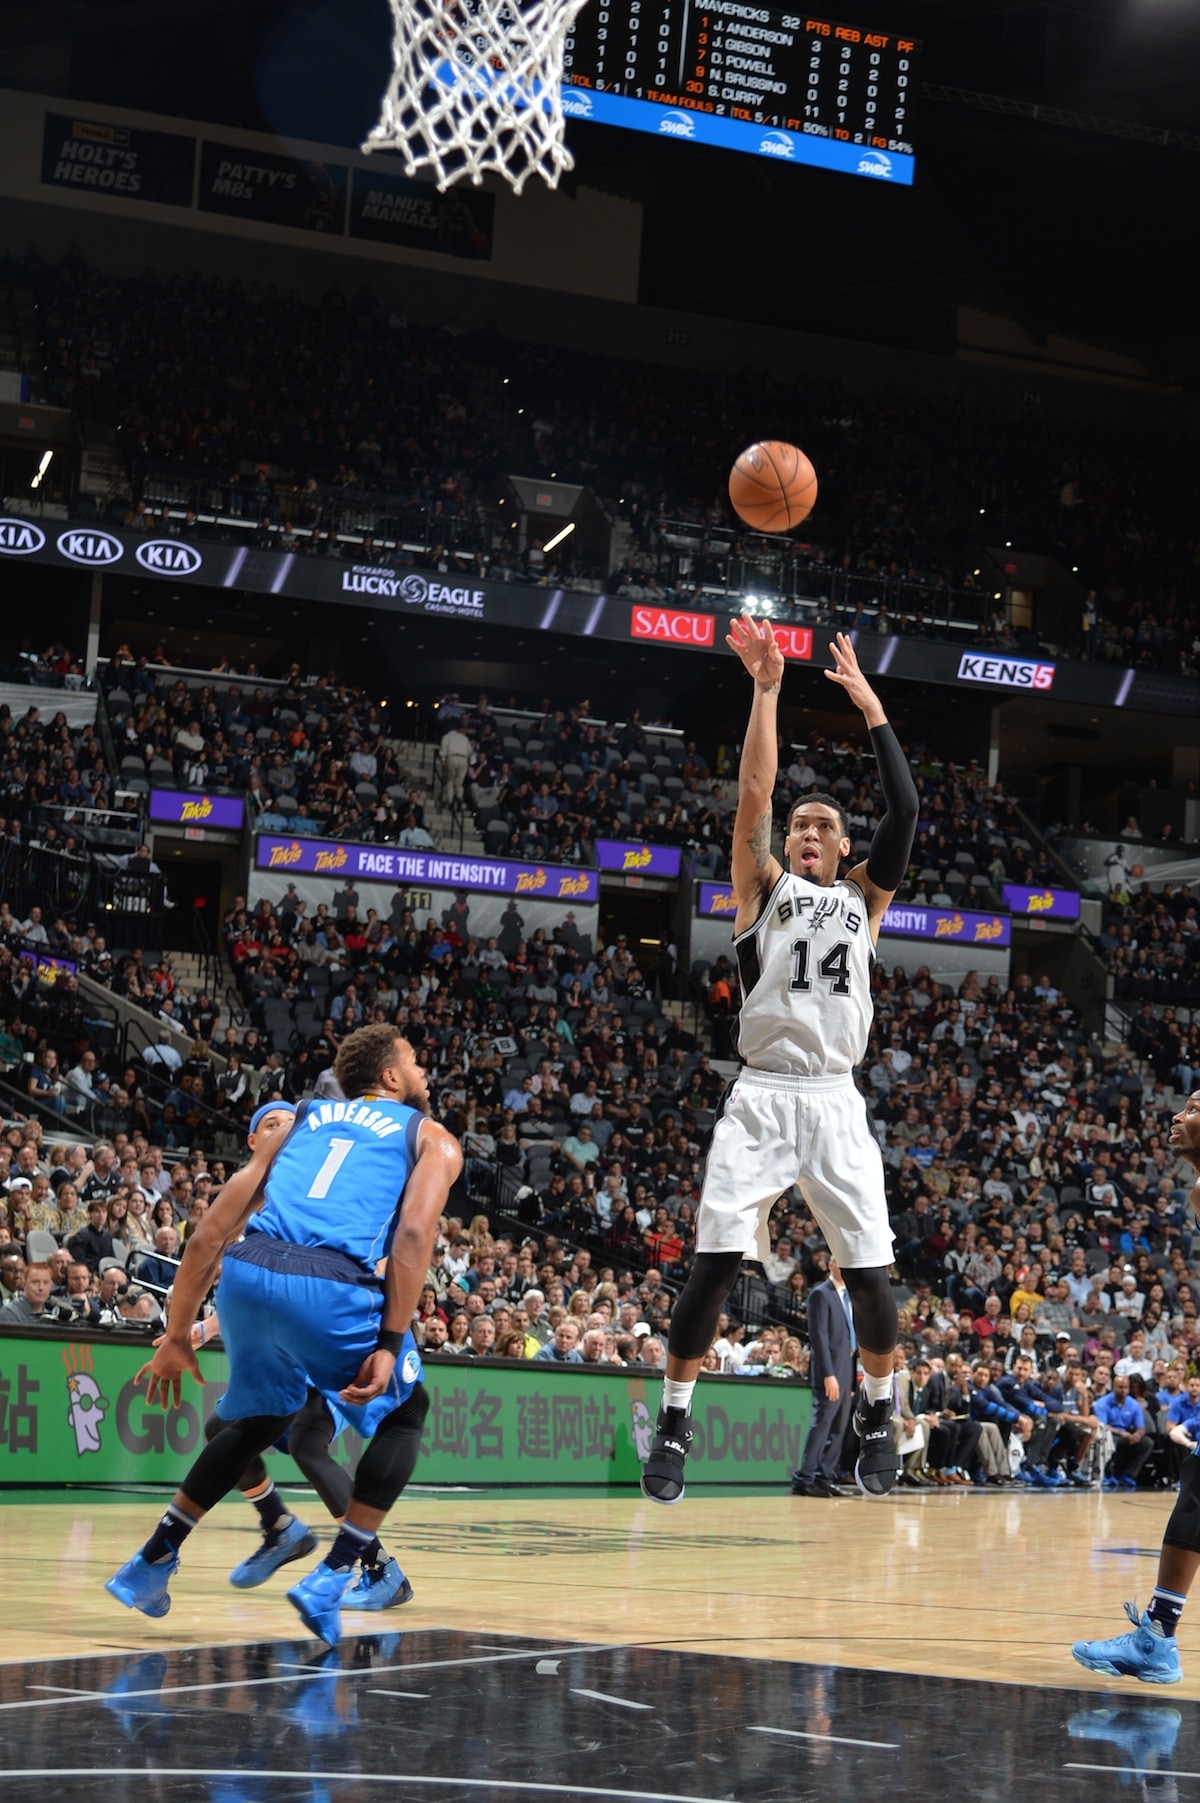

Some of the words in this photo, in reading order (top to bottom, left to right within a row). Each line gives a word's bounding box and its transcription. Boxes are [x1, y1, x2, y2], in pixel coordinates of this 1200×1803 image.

[598, 11, 609, 24] 0
[629, 18, 639, 30] 0
[659, 24, 670, 36] 0
[630, 1, 641, 14] 2
[663, 8, 670, 20] 1
[597, 28, 608, 40] 3
[630, 35, 637, 47] 1
[658, 40, 669, 53] 0
[695, 0, 770, 22] MAVERICKS
[781, 15, 801, 30] 32
[806, 20, 831, 36] PTS
[835, 27, 861, 42] REB
[864, 34, 889, 48] AST
[897, 40, 914, 53] PF
[564, 38, 575, 50] 0
[598, 45, 605, 56] 1
[626, 50, 637, 63] 0
[658, 57, 666, 69] 1
[702, 17, 709, 28] 1
[726, 22, 794, 46] ANDERSON
[811, 40, 822, 52] 3
[841, 47, 851, 59] 3
[870, 53, 880, 65] 0
[899, 59, 909, 71] 0
[596, 61, 604, 73] 1
[625, 67, 635, 80] 0
[655, 73, 666, 86] 0
[698, 49, 707, 60] 7
[725, 55, 776, 76] POWELL
[808, 73, 819, 85] 0
[838, 79, 849, 91] 2
[867, 85, 878, 97] 0
[898, 92, 905, 103] 1
[725, 39, 771, 58] GIBSON
[810, 57, 820, 69] 2
[840, 63, 850, 75] 0
[869, 69, 879, 81] 2
[897, 75, 908, 87] 0
[686, 80, 704, 94] 30
[721, 88, 765, 106] CURRY
[804, 105, 819, 118] 11
[837, 112, 845, 123] 1
[865, 118, 875, 129] 2
[895, 124, 903, 135] 1
[724, 72, 787, 94] BRUSSINO
[807, 89, 818, 101] 0
[837, 95, 848, 107] 0
[866, 101, 876, 113] 0
[895, 107, 905, 119] 2
[572, 73, 592, 88] TOL
[635, 87, 642, 98] 1
[647, 90, 677, 105] TEAM
[679, 97, 713, 113] FOULS
[716, 104, 725, 115] 2
[733, 107, 752, 120] TOL
[787, 119, 801, 130] FT
[803, 122, 828, 136] 50%
[835, 128, 849, 140] TO
[854, 133, 863, 144] 2
[872, 136, 887, 148] FG
[888, 140, 914, 154] 54%
[658, 120, 695, 138] SWBC
[60, 140, 138, 170] HOLT'S
[758, 140, 795, 158] SWBC
[54, 161, 143, 192] HEROES
[217, 160, 297, 190] PATTY'S
[857, 160, 893, 178] SWBC
[211, 178, 254, 199] M8s
[366, 190, 433, 214] MANU'S
[362, 205, 439, 230] MANIACS
[68, 535, 112, 559] KIA
[147, 546, 190, 569] KIA
[352, 565, 396, 577] KICKAPOO
[342, 571, 400, 596] LUCKY
[427, 583, 484, 608] EAGLE
[635, 610, 711, 641] SACU
[180, 797, 213, 821] Takis
[269, 842, 302, 867] Takis
[314, 847, 348, 872] Takis
[358, 852, 394, 874] FACE
[397, 857, 425, 878] THE
[428, 860, 507, 886] INTENSITY!
[514, 870, 547, 892] Takis
[558, 874, 590, 897] Takis
[622, 847, 653, 870] Takis
[404, 892, 430, 909] 111
[1027, 893, 1055, 913] Takis
[777, 896, 862, 936] SPUS
[880, 907, 927, 931] ENSITY!
[935, 915, 964, 938] Takis
[974, 920, 1003, 941] Takis
[789, 938, 852, 997] 14
[307, 1102, 403, 1139] ANDERSON
[306, 1137, 355, 1199] 1
[419, 1386, 503, 1459] 域名
[516, 1391, 616, 1460] 建网站
[690, 1405, 801, 1478] oDaddy
